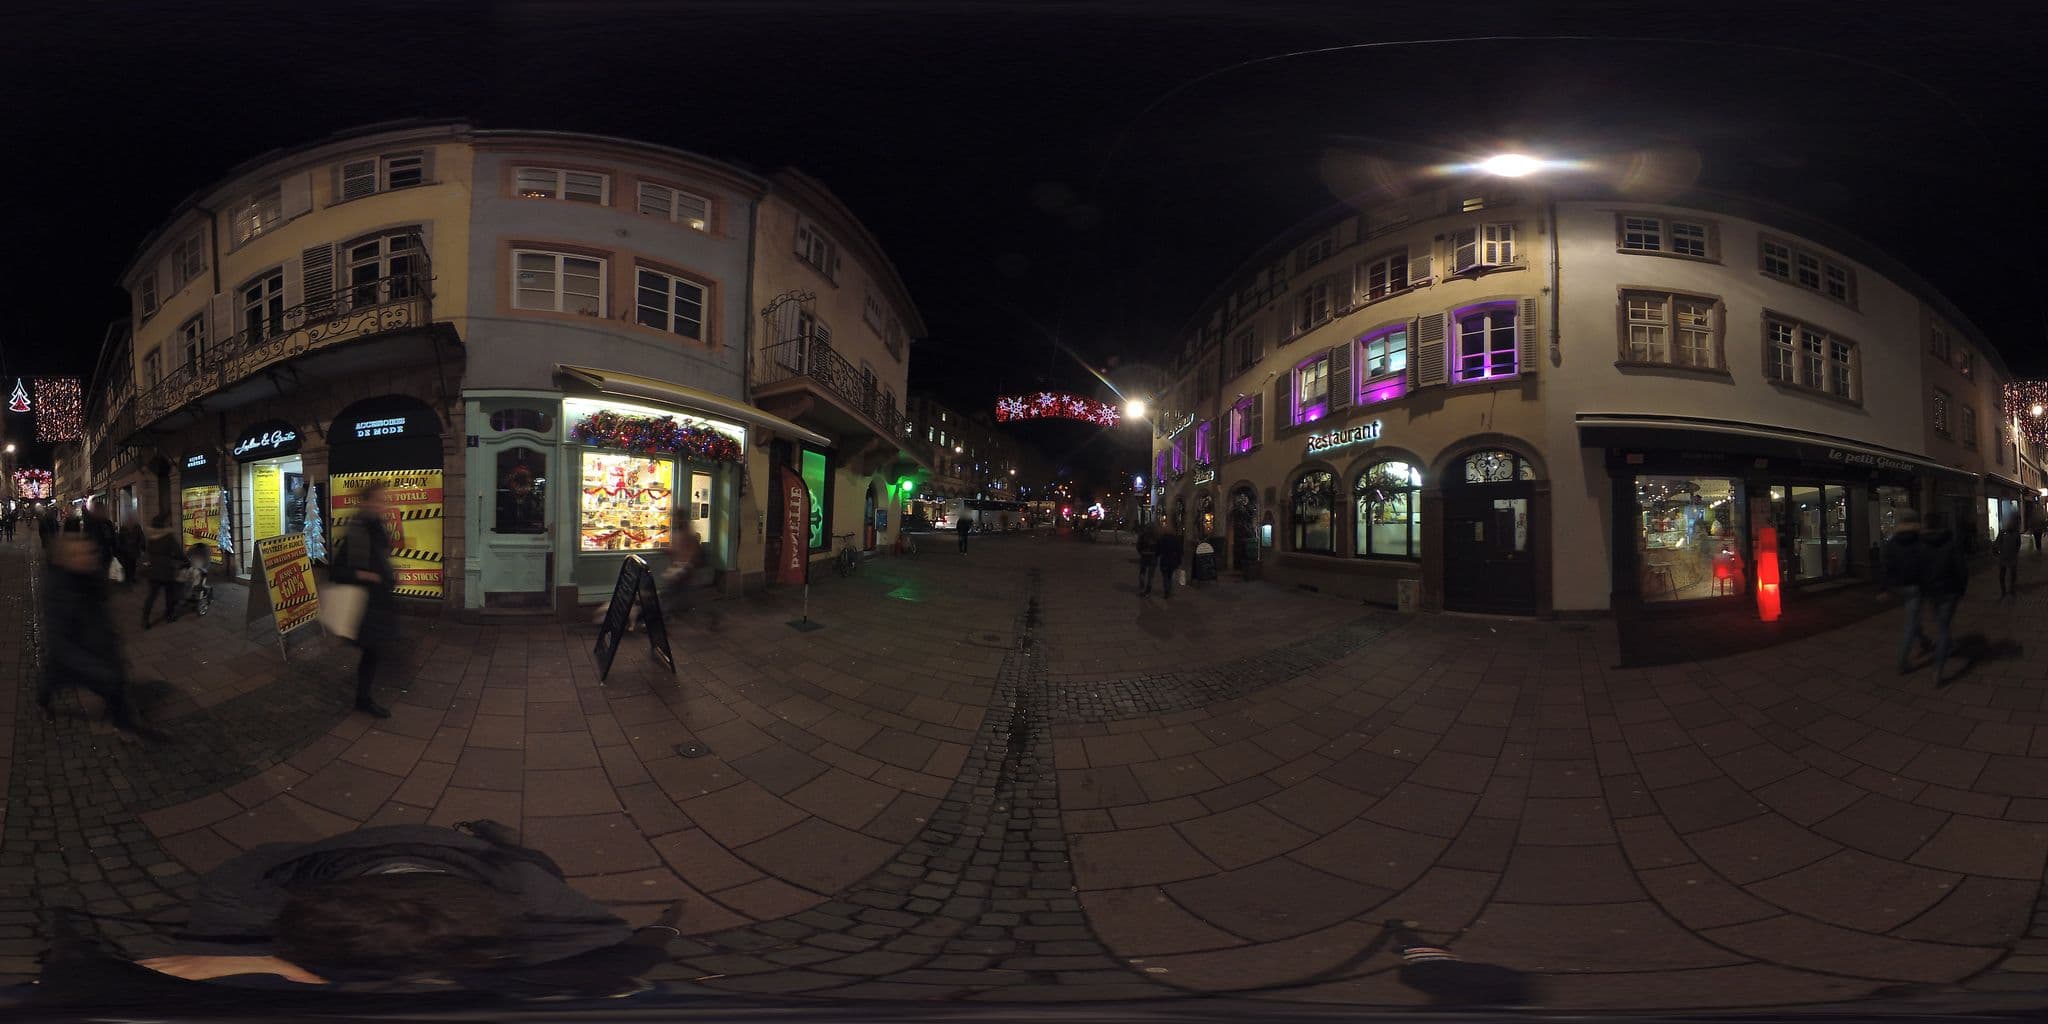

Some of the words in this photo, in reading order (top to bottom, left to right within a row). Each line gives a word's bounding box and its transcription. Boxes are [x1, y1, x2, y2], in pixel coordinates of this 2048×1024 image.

[355, 417, 406, 430] ACCESSOIRES
[357, 428, 372, 438] DE
[374, 425, 405, 436] MODE
[1307, 419, 1382, 453] Restaurant
[261, 432, 270, 446] &
[1845, 453, 1874, 465] petit
[1877, 456, 1914, 471] Glacier
[394, 477, 428, 488] BIJOUX
[396, 492, 428, 502] TOTALE
[412, 573, 439, 581] STOCKS
